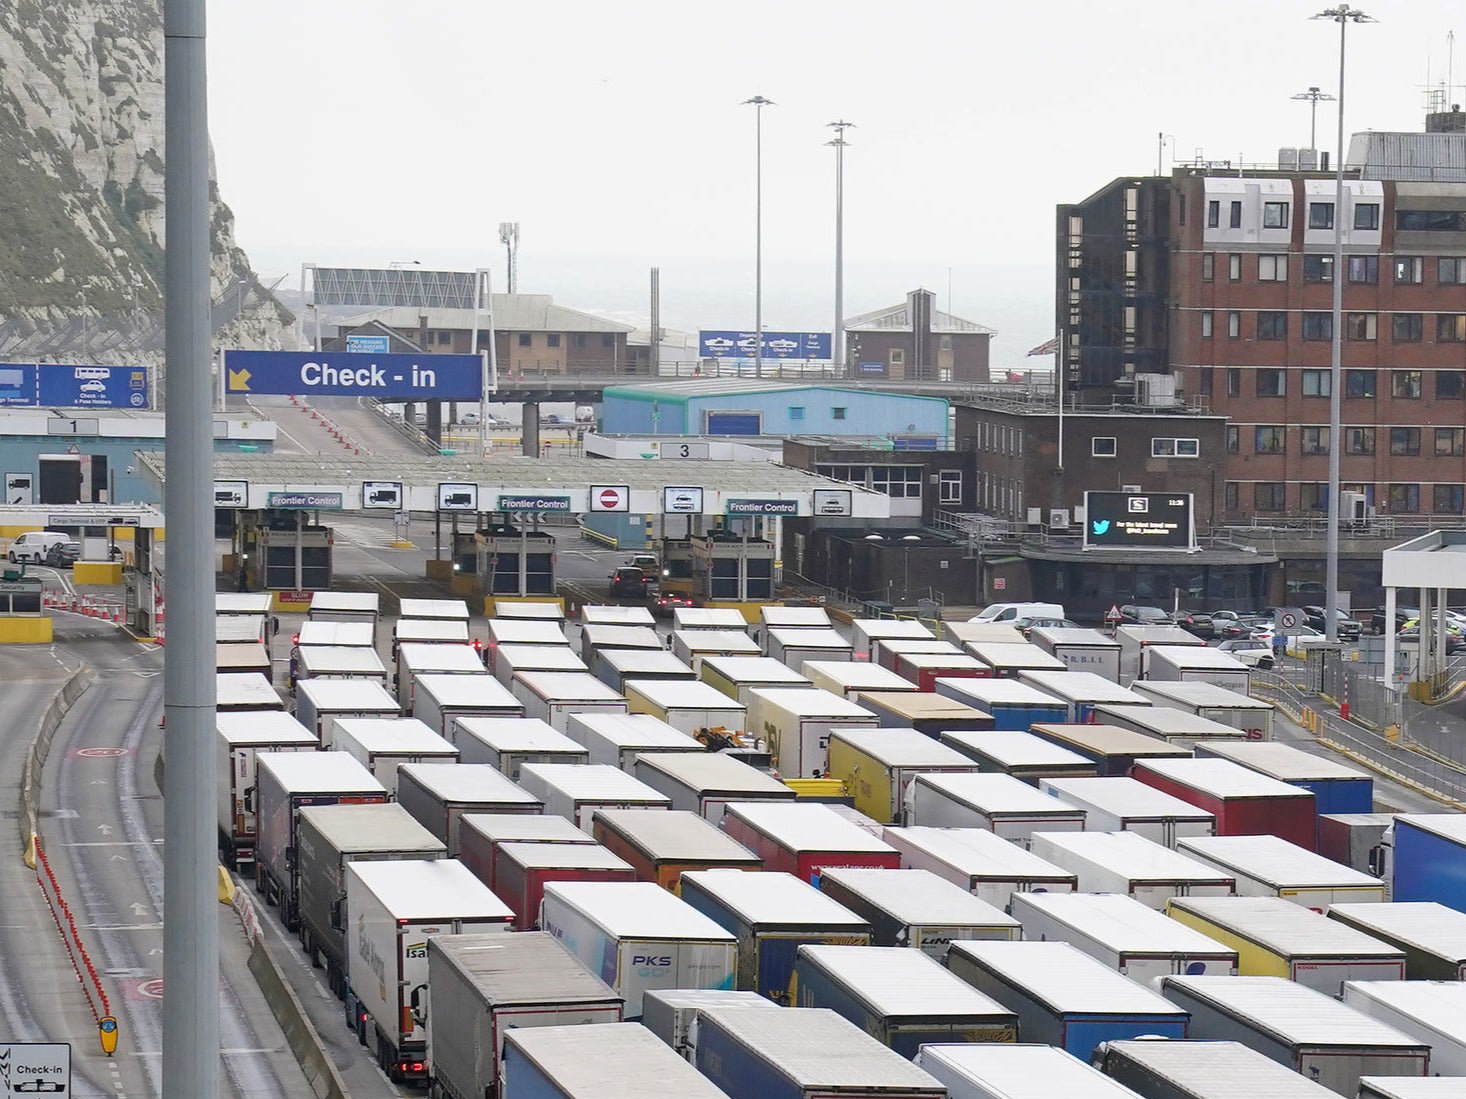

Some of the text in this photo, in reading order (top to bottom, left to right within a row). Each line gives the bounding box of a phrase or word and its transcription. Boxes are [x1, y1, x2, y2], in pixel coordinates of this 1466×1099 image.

[301, 362, 386, 388] Check
[412, 365, 435, 388] in
[70, 420, 77, 433] 1
[680, 444, 690, 458] 3
[271, 496, 341, 506] Frontier Control
[501, 498, 569, 509] Frontier Control
[730, 502, 797, 513] Frontier Control
[406, 949, 429, 959] Isa
[632, 955, 671, 966] PKS
[17, 1065, 63, 1074] Check-in
